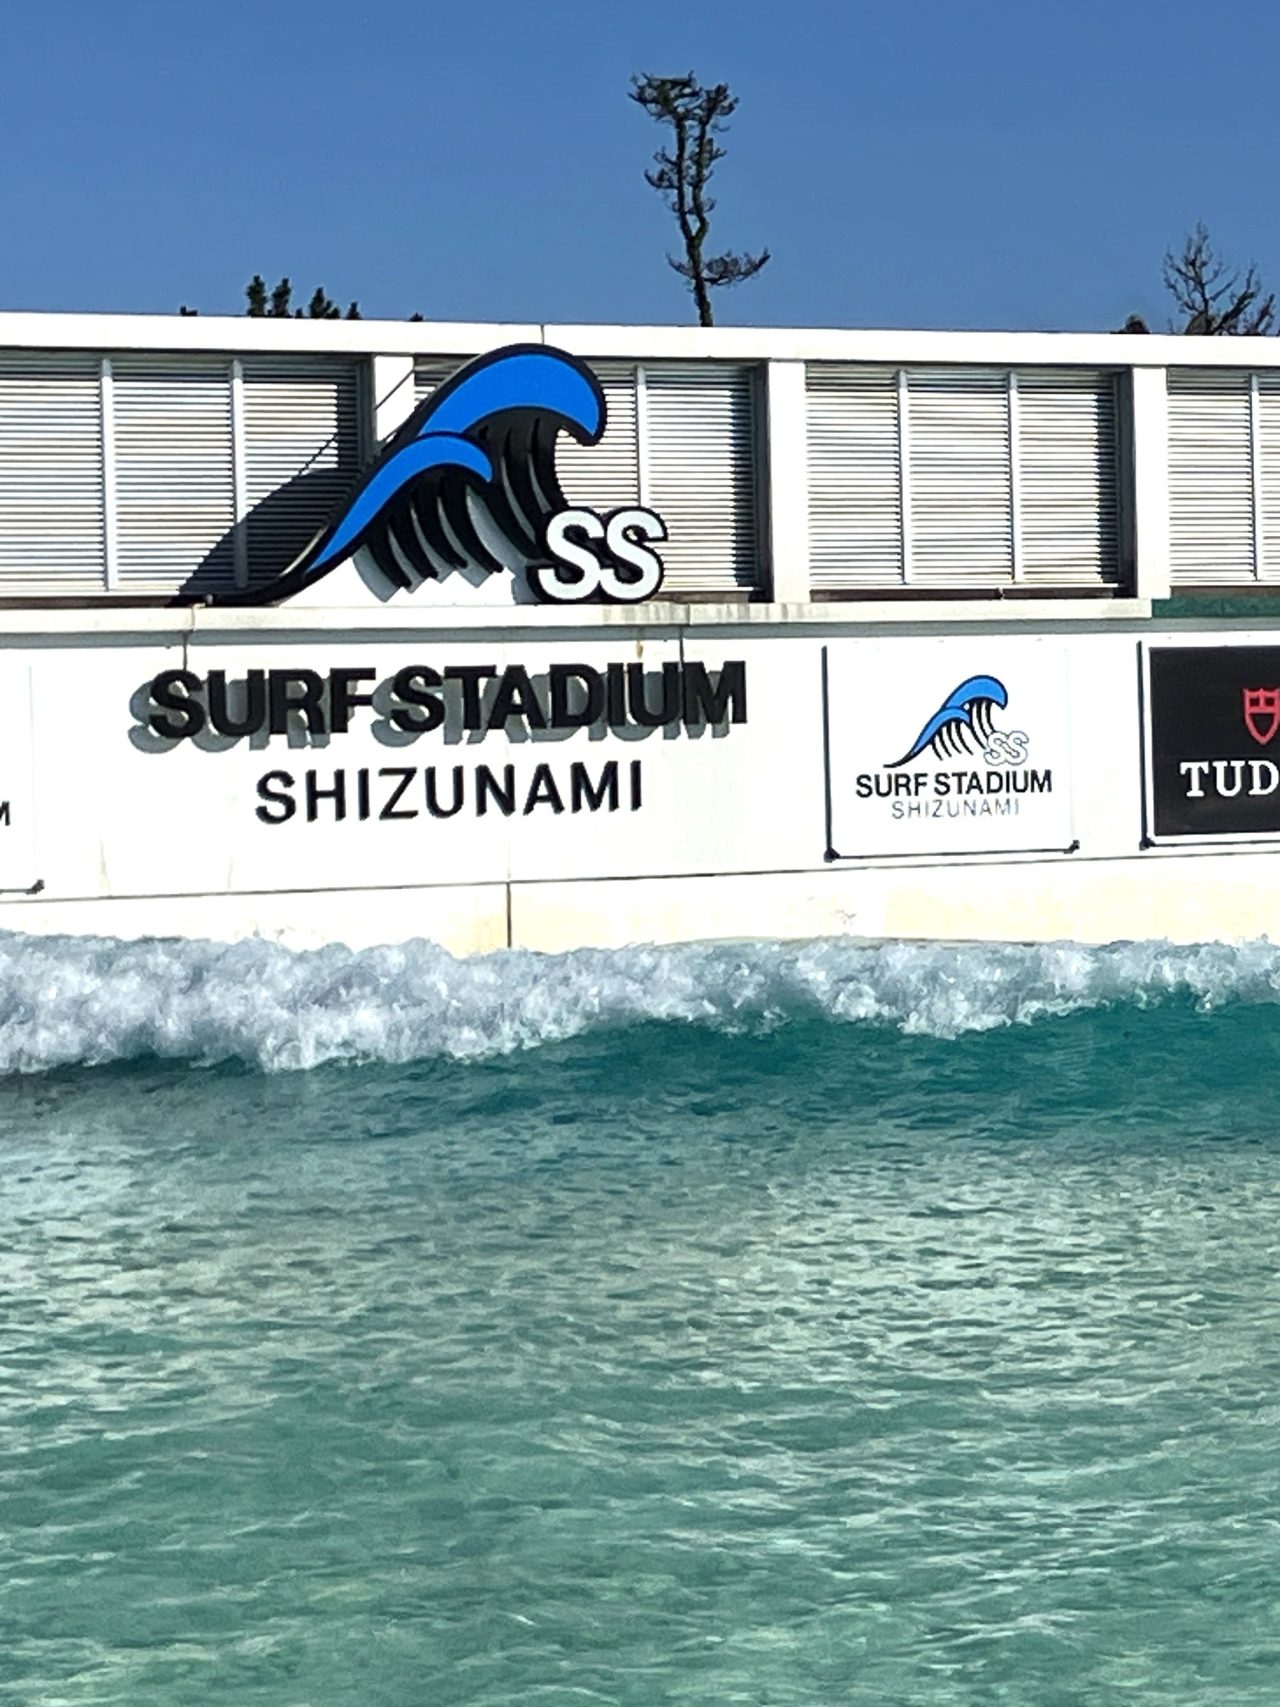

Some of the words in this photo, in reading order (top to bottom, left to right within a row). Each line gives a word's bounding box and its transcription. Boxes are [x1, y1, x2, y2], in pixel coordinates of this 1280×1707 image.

[527, 506, 668, 604] SS
[148, 667, 377, 739] SURF
[388, 660, 748, 734] STADIUM
[255, 760, 643, 826] SHIZUNAMI
[855, 773, 929, 799] SURF
[933, 769, 1052, 796] STADIUM
[891, 798, 1020, 820] SHIZUNAMI
